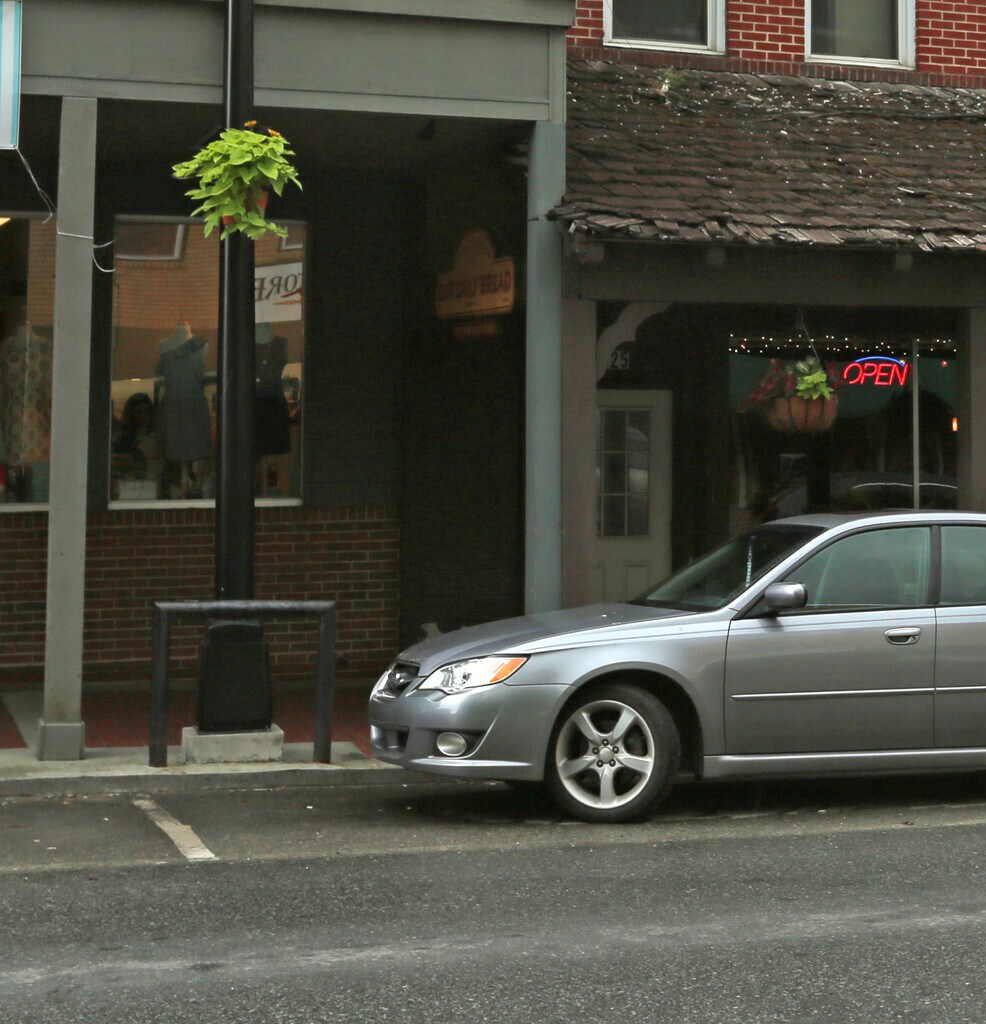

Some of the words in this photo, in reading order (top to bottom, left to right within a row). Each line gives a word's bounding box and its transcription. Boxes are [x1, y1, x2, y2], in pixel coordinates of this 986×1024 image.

[455, 275, 479, 298] DAILY
[480, 271, 512, 294] BREAD
[843, 362, 910, 387] OPEN
